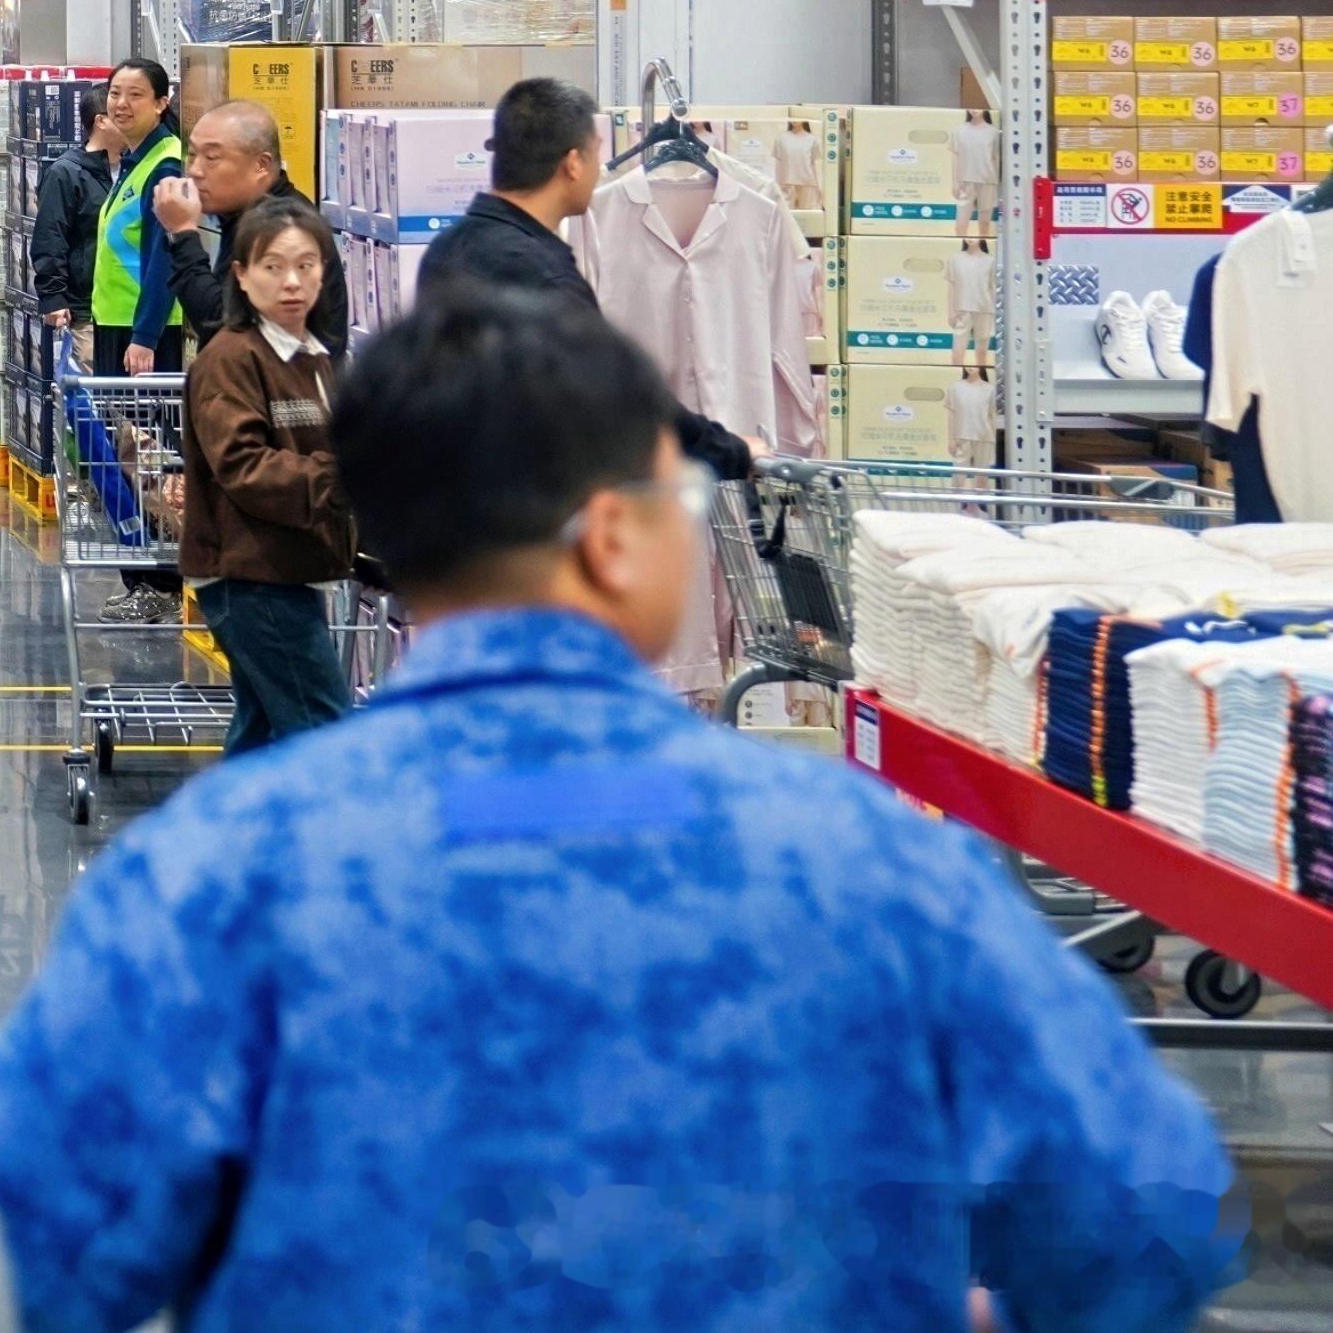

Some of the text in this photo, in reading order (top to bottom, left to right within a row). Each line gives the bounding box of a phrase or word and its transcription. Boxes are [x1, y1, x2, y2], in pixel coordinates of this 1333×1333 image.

[1111, 45, 1129, 59] 36
[1193, 47, 1212, 60] 36
[1277, 43, 1296, 56] 36
[1113, 99, 1132, 112] 36
[1195, 101, 1215, 114] 36
[1280, 99, 1298, 112] 37
[1114, 155, 1133, 169] 36
[1197, 155, 1216, 169] 36
[1280, 157, 1298, 170] 37
